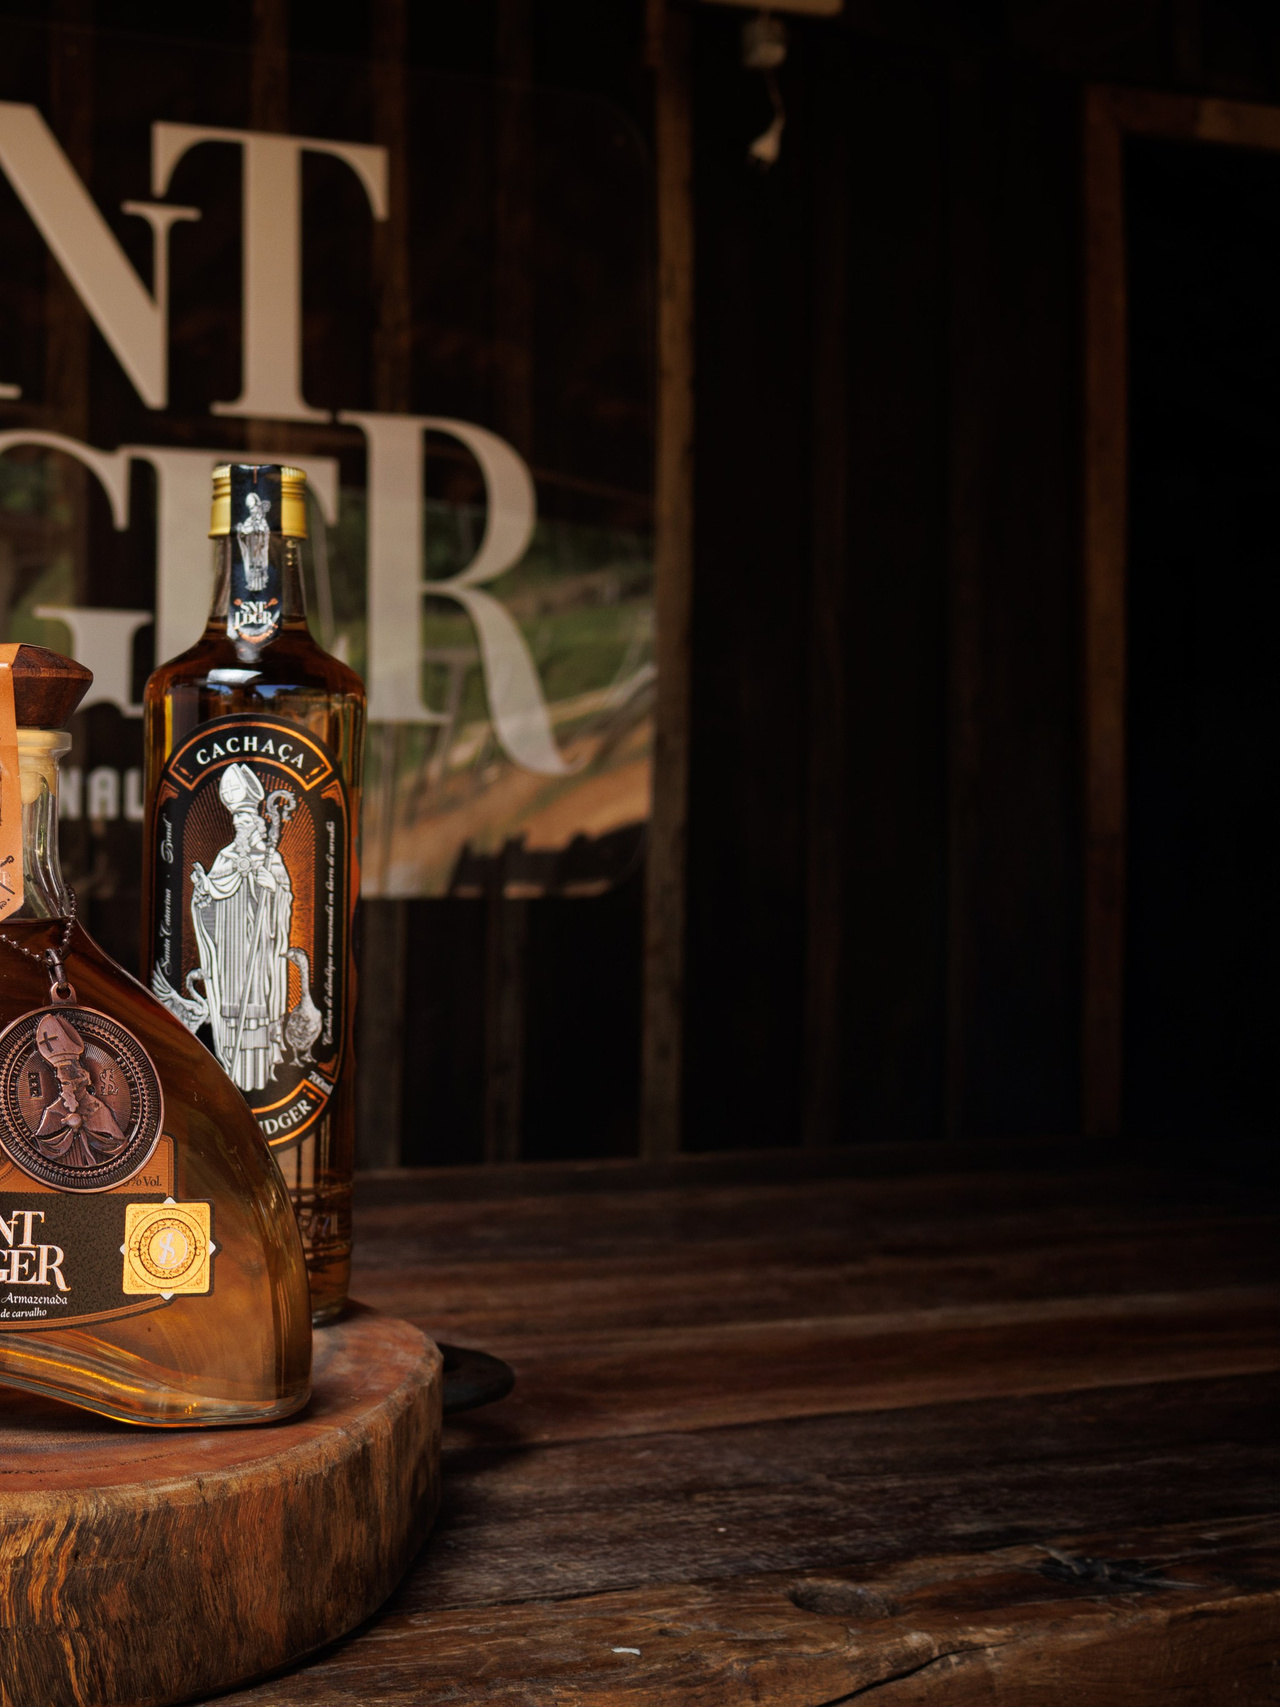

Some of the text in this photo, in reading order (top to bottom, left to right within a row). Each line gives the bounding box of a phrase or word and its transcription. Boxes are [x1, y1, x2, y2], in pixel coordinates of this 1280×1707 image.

[240, 601, 267, 613] SNT
[234, 611, 274, 626] LDGR
[195, 735, 306, 769] CACHAÇA
[307, 1070, 334, 1095] 700ml
[258, 1099, 312, 1135] DGER
[143, 1175, 163, 1187] Vol.
[1, 1290, 68, 1305] Armazenada
[0, 1307, 11, 1317] de
[11, 1305, 47, 1317] carvalho
